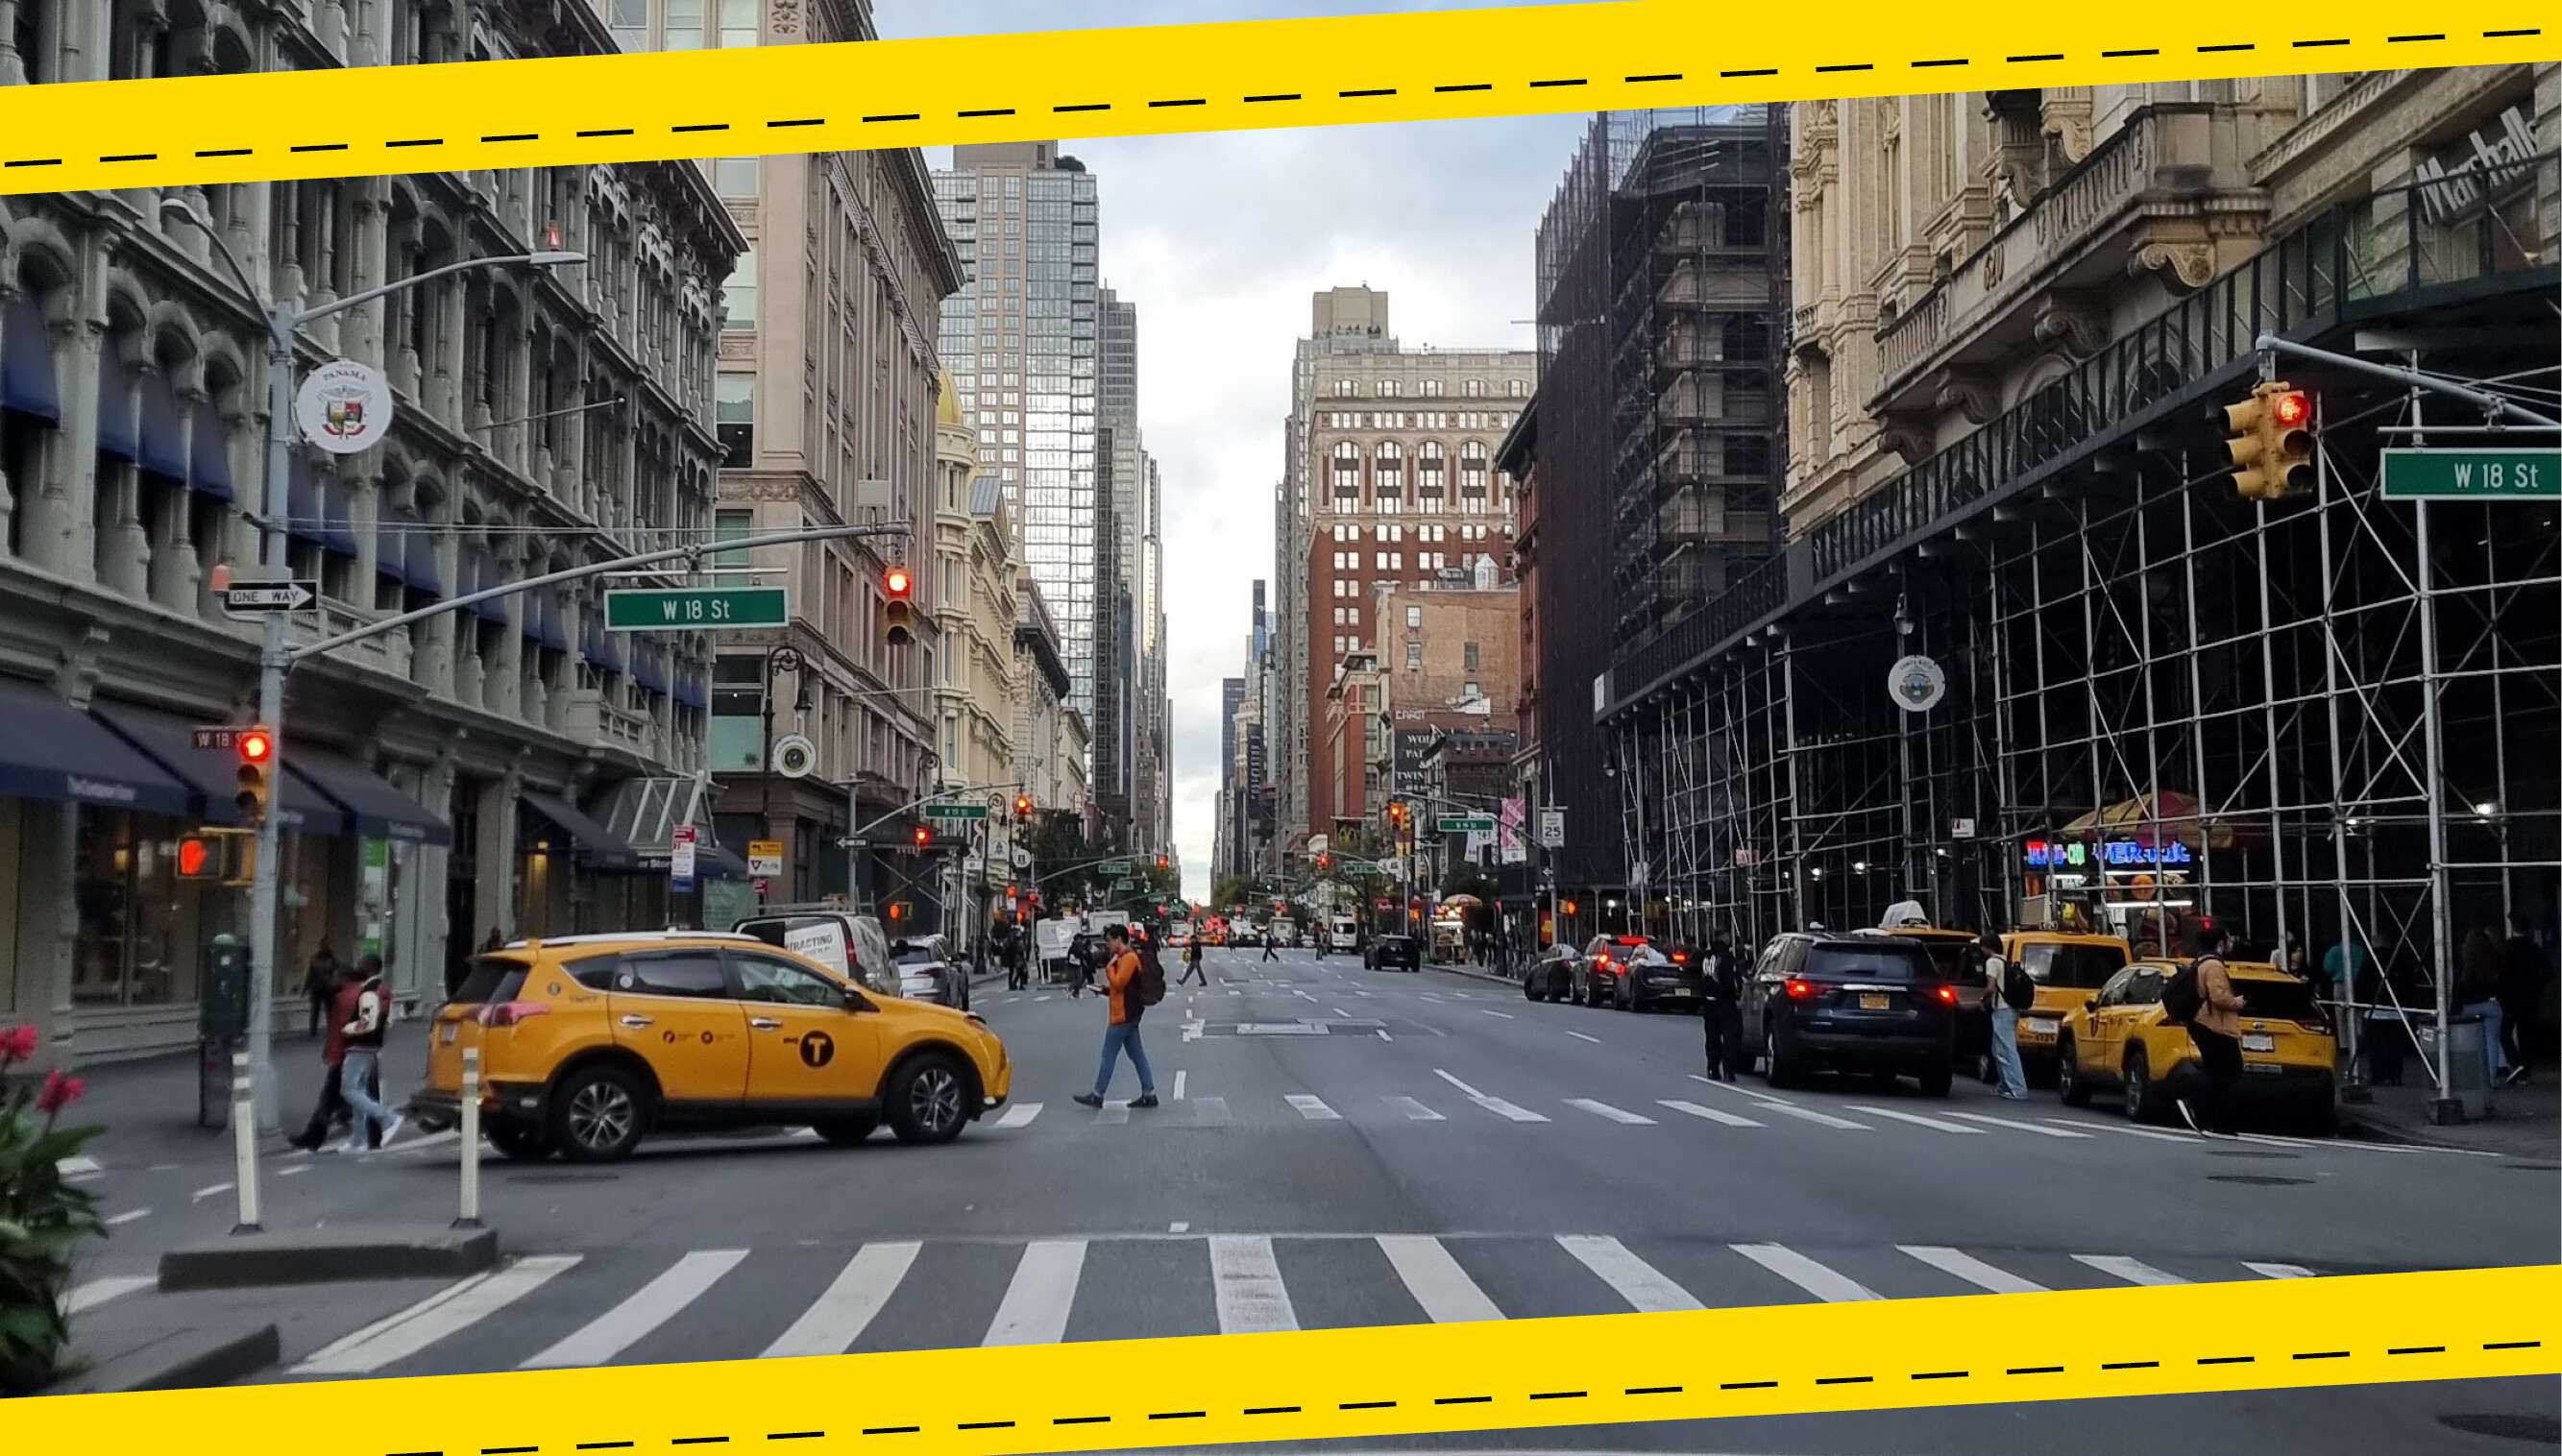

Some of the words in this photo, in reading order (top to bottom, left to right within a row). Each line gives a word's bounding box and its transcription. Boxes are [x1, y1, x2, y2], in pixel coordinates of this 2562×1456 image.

[323, 370, 366, 381] PANAMA
[2454, 463, 2472, 488] W
[2482, 463, 2503, 488] 18
[2514, 463, 2539, 488] St
[233, 591, 259, 602] ONE
[271, 591, 298, 601] WAY
[663, 600, 677, 620] W
[685, 599, 703, 619] 18
[711, 599, 730, 619] St
[197, 733, 209, 746] W
[216, 733, 230, 746] 18
[1396, 771, 1427, 780] TWIN
[1545, 826, 1561, 837] 25
[785, 934, 833, 953] TRACTING
[809, 1037, 827, 1063] T
